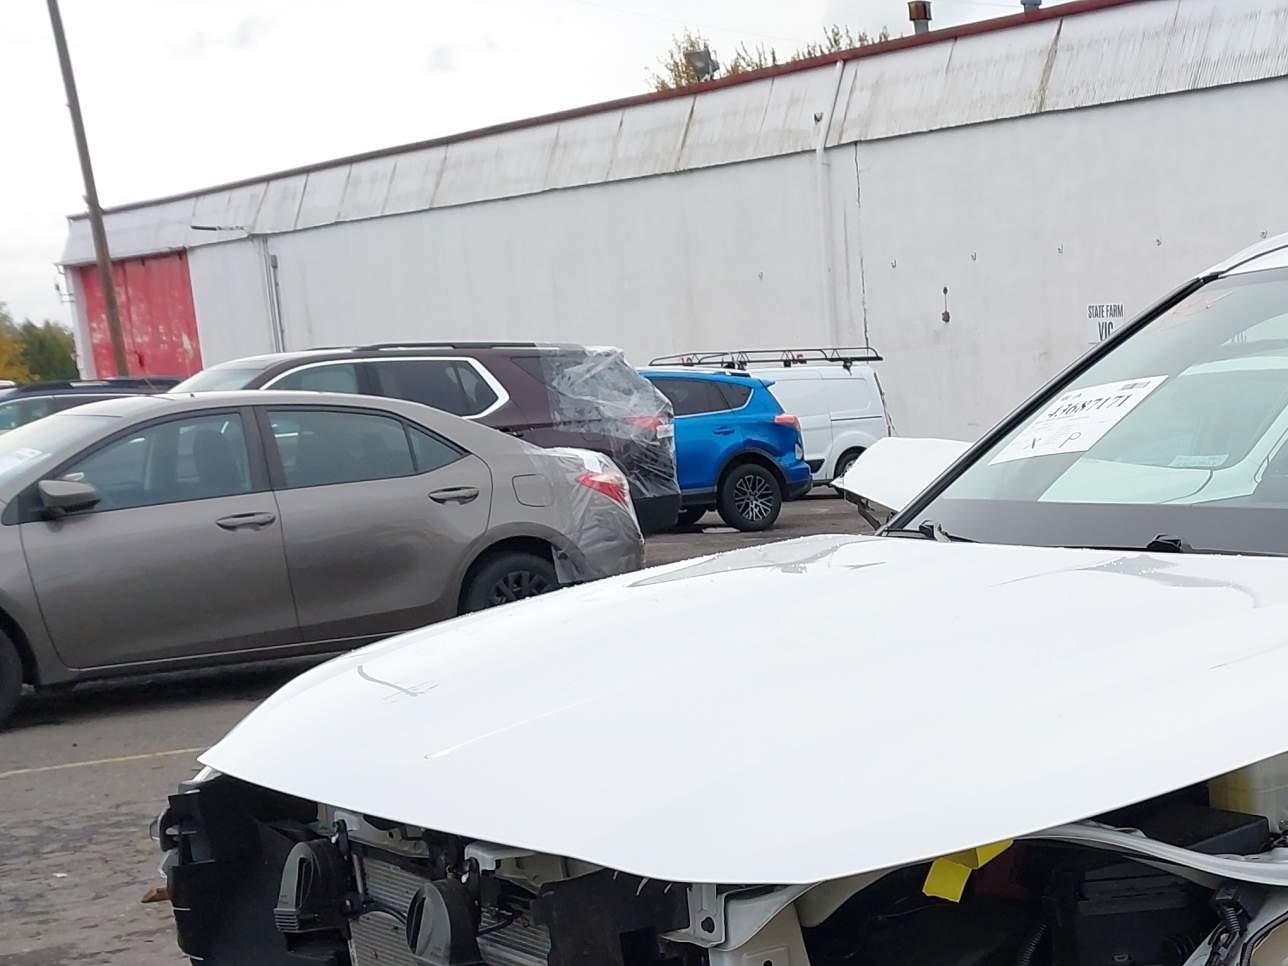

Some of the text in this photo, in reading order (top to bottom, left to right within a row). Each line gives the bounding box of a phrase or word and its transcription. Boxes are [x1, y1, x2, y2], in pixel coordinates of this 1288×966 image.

[1088, 304, 1124, 319] STATE FARM
[1048, 393, 1133, 418] 43687171
